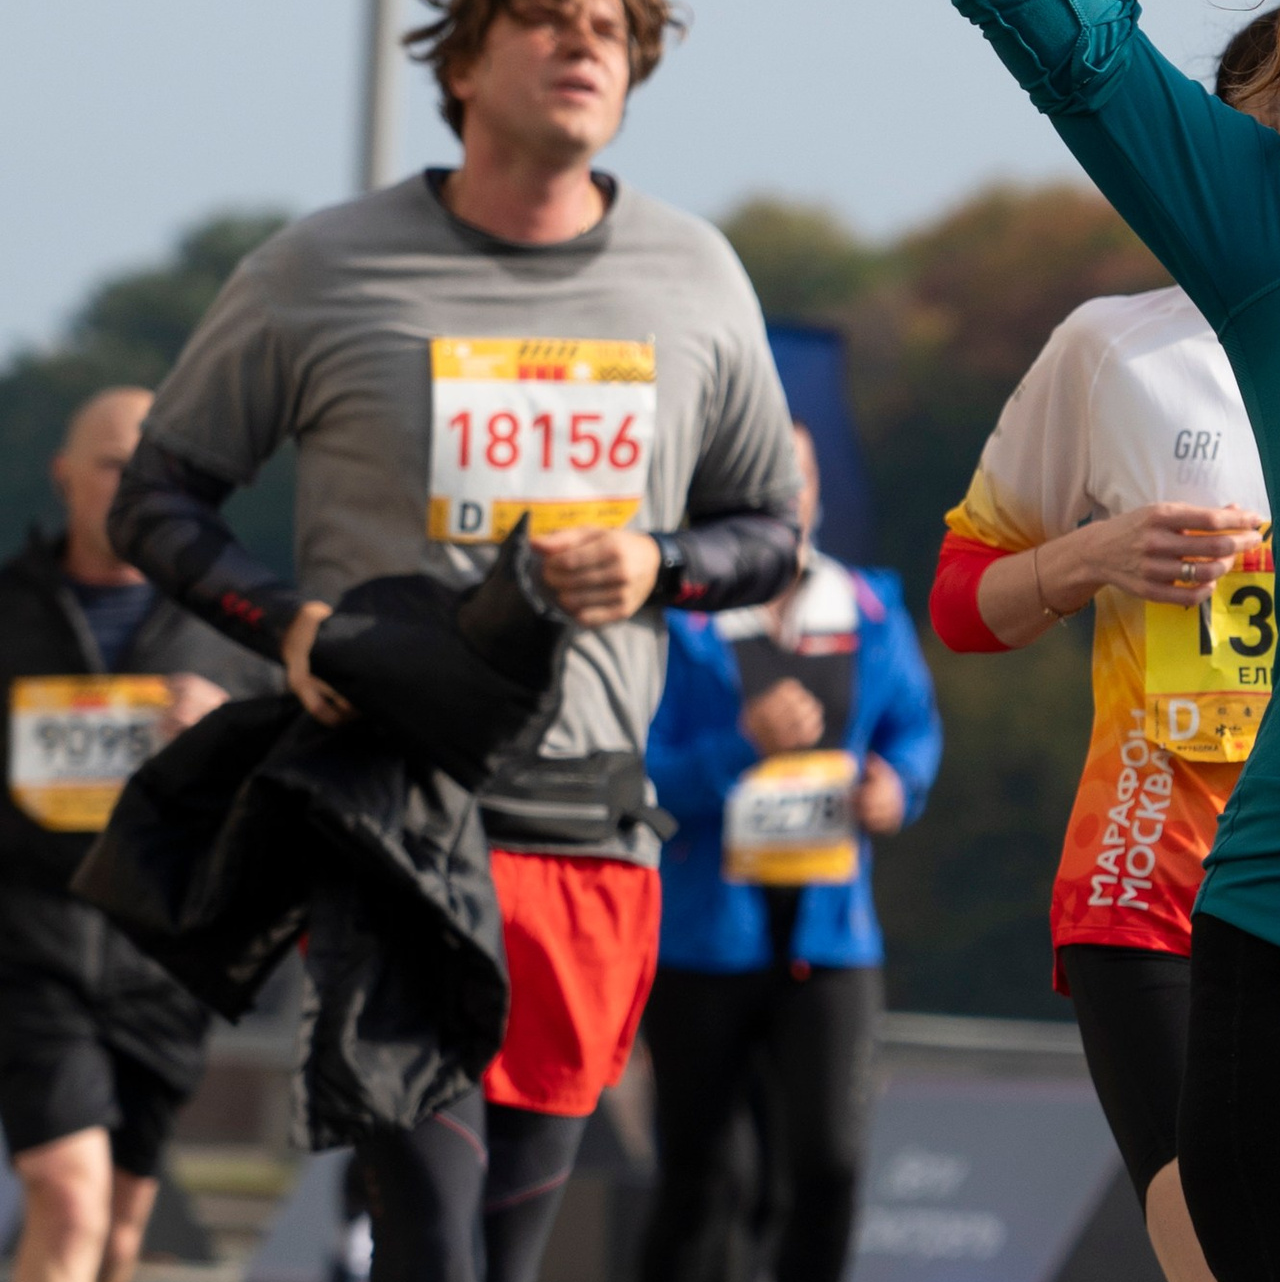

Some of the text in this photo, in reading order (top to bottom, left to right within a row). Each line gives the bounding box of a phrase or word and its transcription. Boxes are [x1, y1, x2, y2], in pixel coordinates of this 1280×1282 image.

[448, 411, 642, 471] 18156
[459, 501, 484, 534] D
[1238, 667, 1273, 686] ЕЛ
[1167, 698, 1200, 741] D
